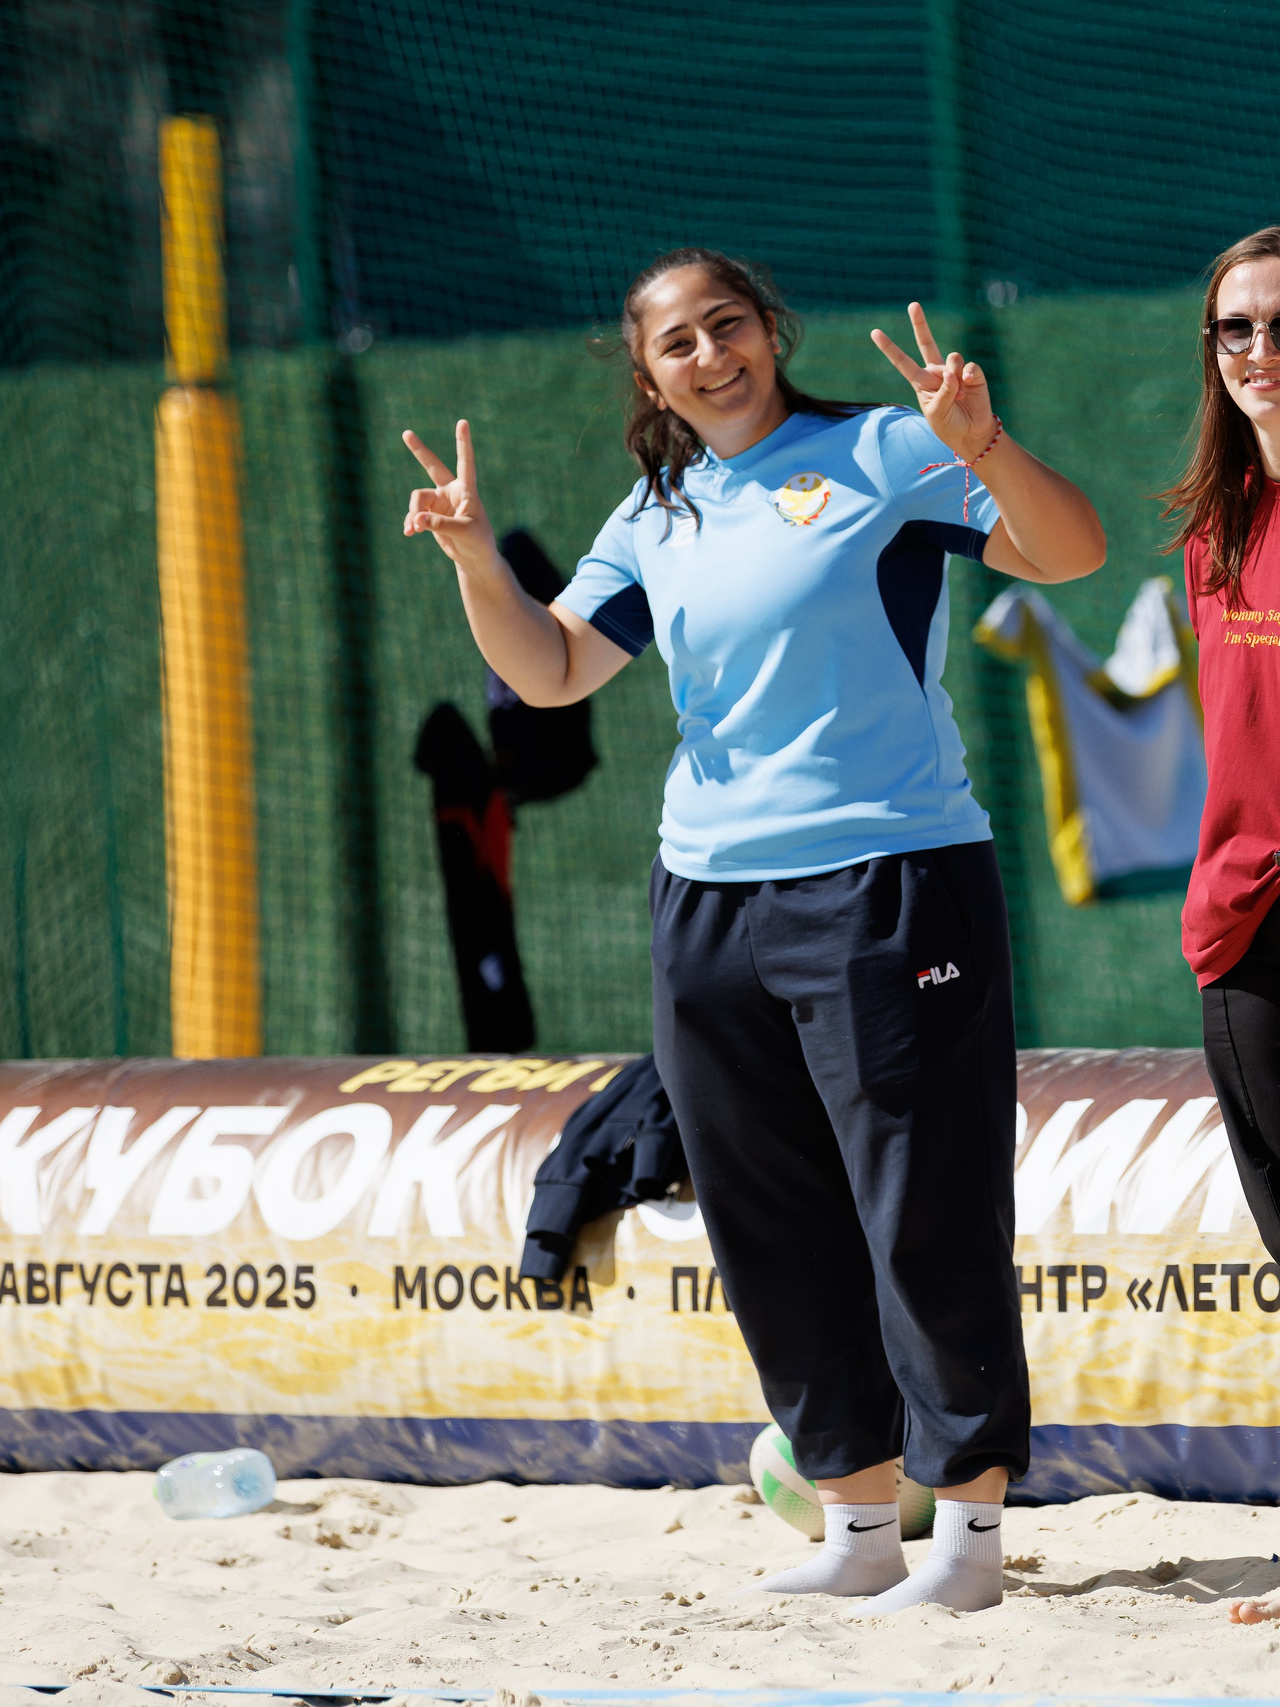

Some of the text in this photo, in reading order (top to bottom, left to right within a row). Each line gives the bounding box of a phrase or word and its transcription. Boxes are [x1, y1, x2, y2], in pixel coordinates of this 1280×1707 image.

[1221, 609, 1264, 623] Mommy
[1224, 631, 1242, 644] I'm
[916, 961, 960, 989] FILA
[338, 1059, 607, 1093] РЕГБИ
[0, 1104, 522, 1241] КУБОК
[0, 1262, 191, 1308] АВГУСТА
[203, 1263, 317, 1309] 2025
[393, 1264, 594, 1311] МОСКВА
